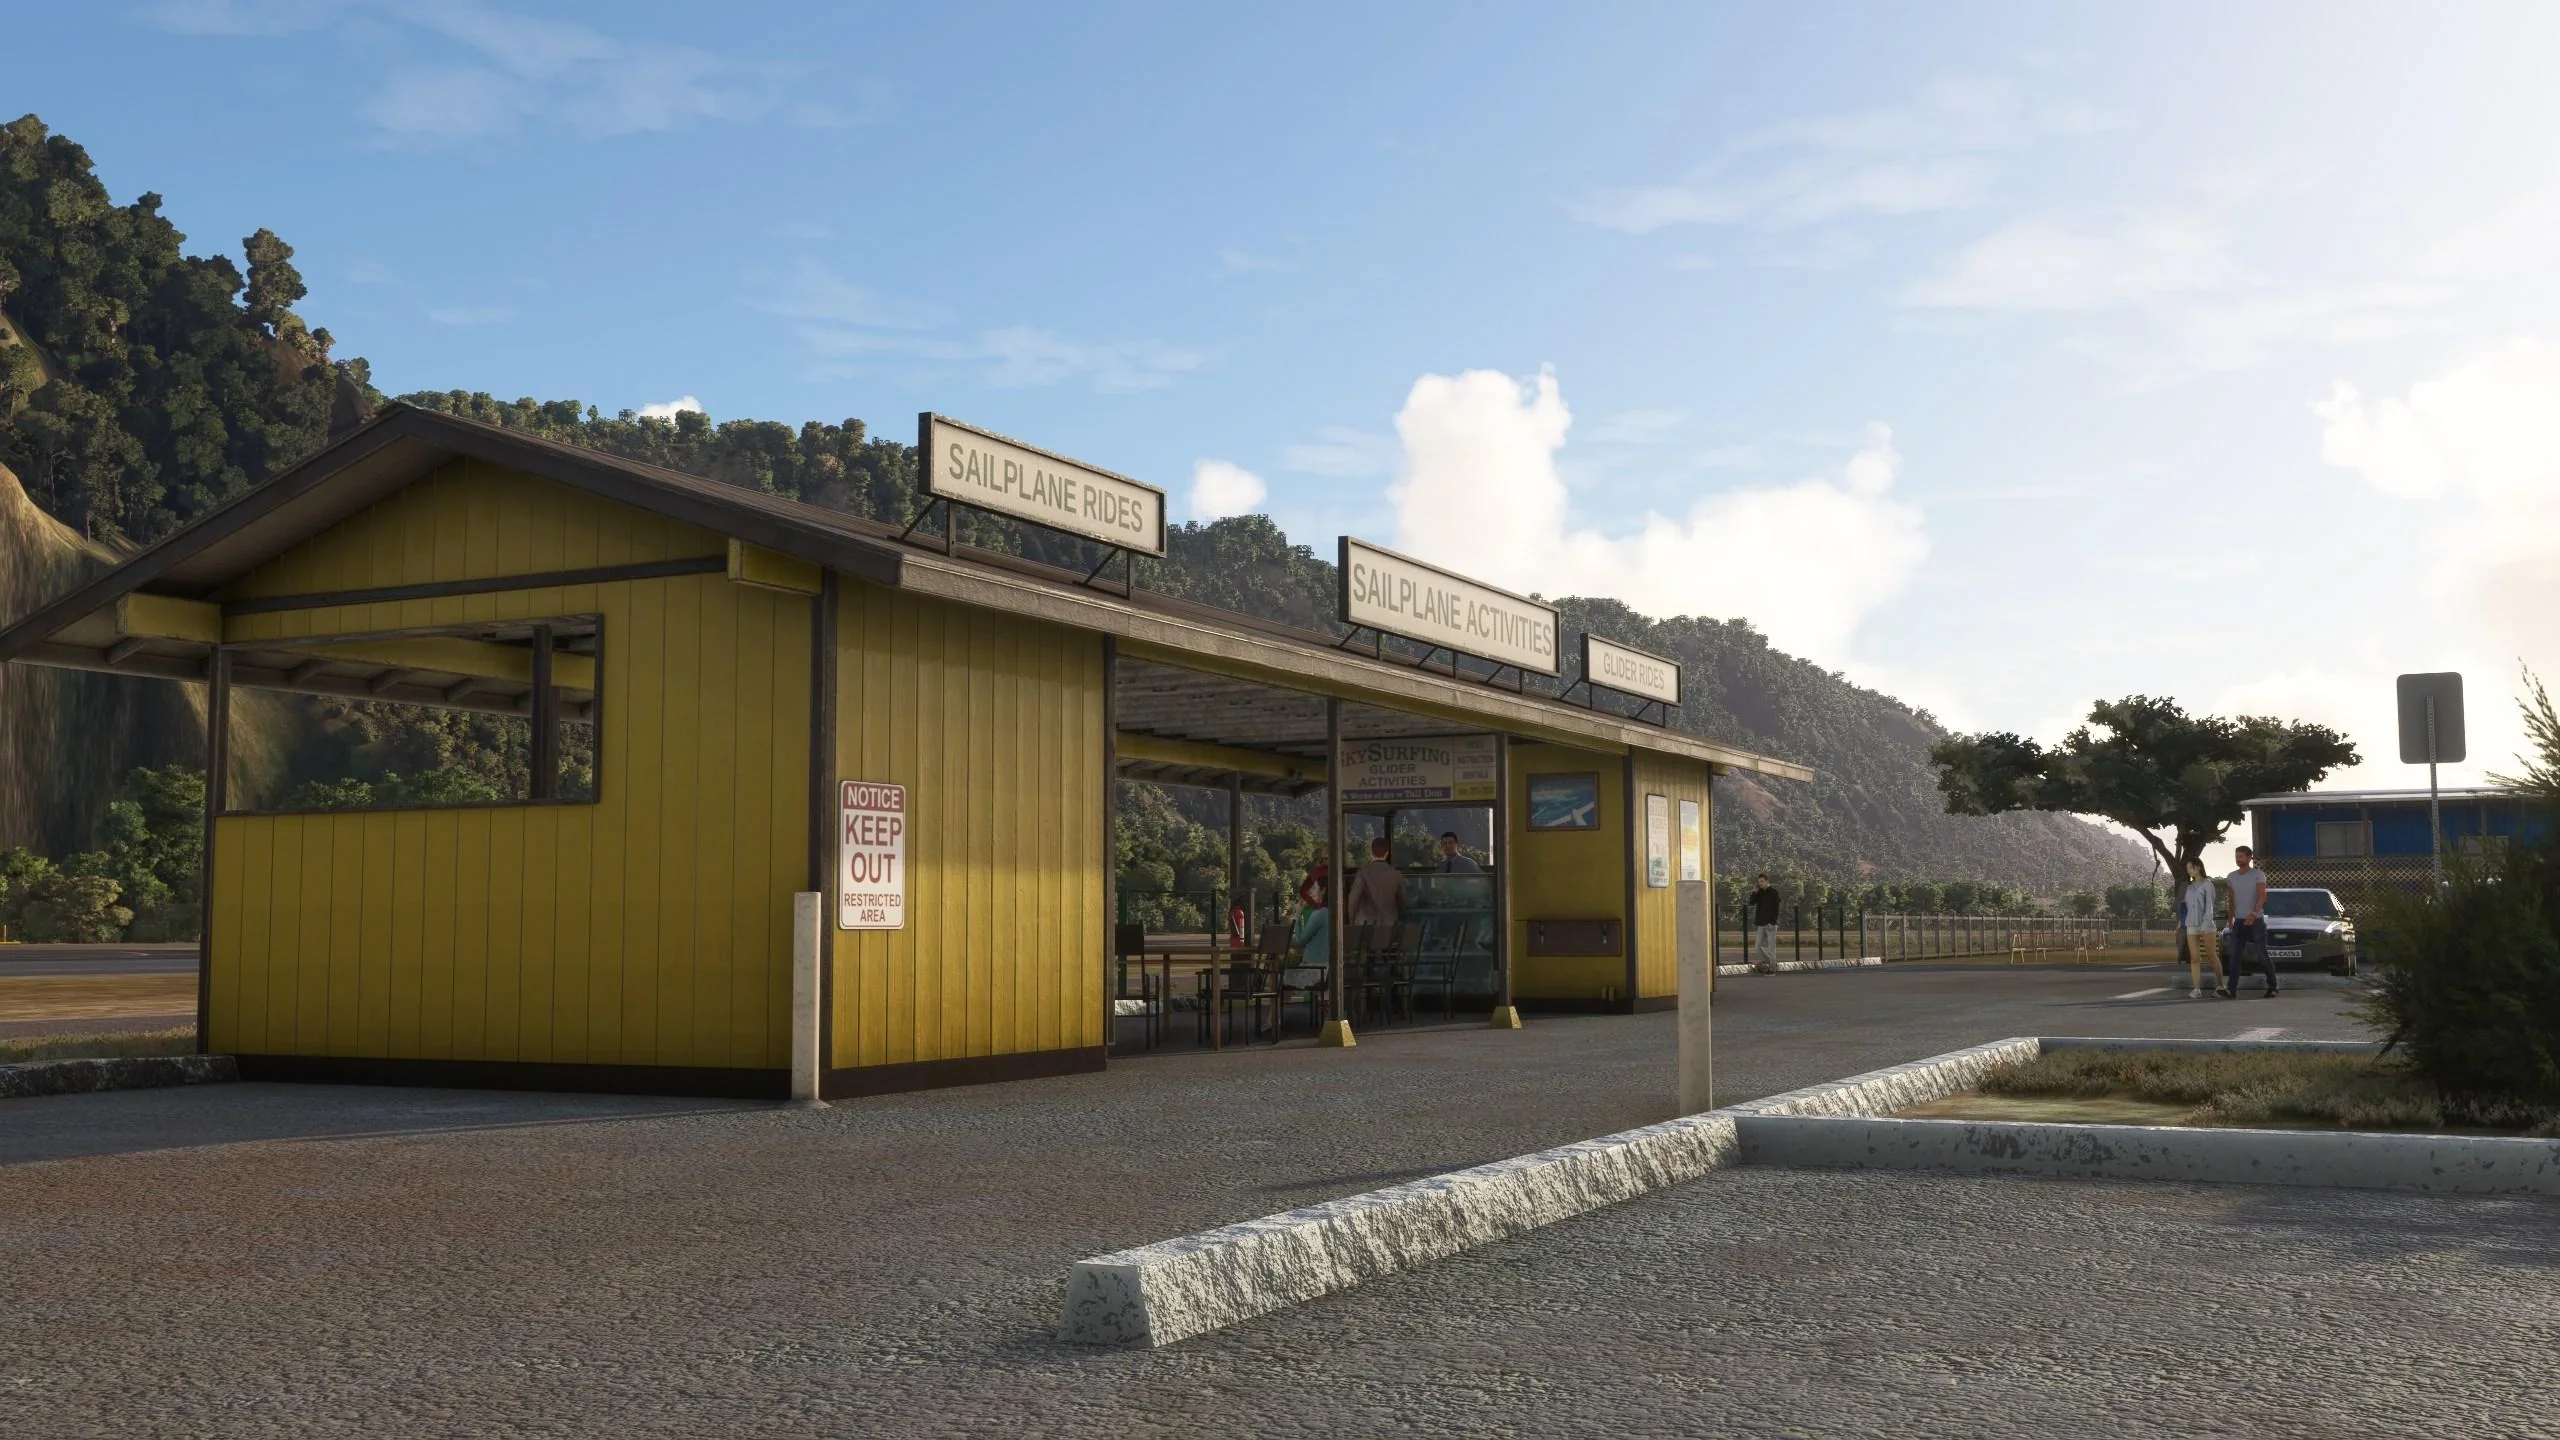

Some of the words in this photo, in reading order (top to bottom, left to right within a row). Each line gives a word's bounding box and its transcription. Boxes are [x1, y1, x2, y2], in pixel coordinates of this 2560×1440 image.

[948, 442, 1077, 514] SAILPLANE
[1083, 484, 1144, 533] RIDES
[1353, 563, 1462, 631] SAILPLANE
[1466, 600, 1553, 657] ACTIVITIES
[1603, 652, 1637, 683] GLIDER
[1639, 663, 1665, 690] RIDES
[1359, 775, 1427, 787] ACTIVITIES
[1369, 763, 1416, 774] GLIDER
[847, 786, 900, 809] NOTICE
[845, 814, 902, 847] KEEP
[851, 852, 896, 884] OUT
[844, 893, 901, 907] RESTRICTED
[860, 909, 886, 922] AREA
